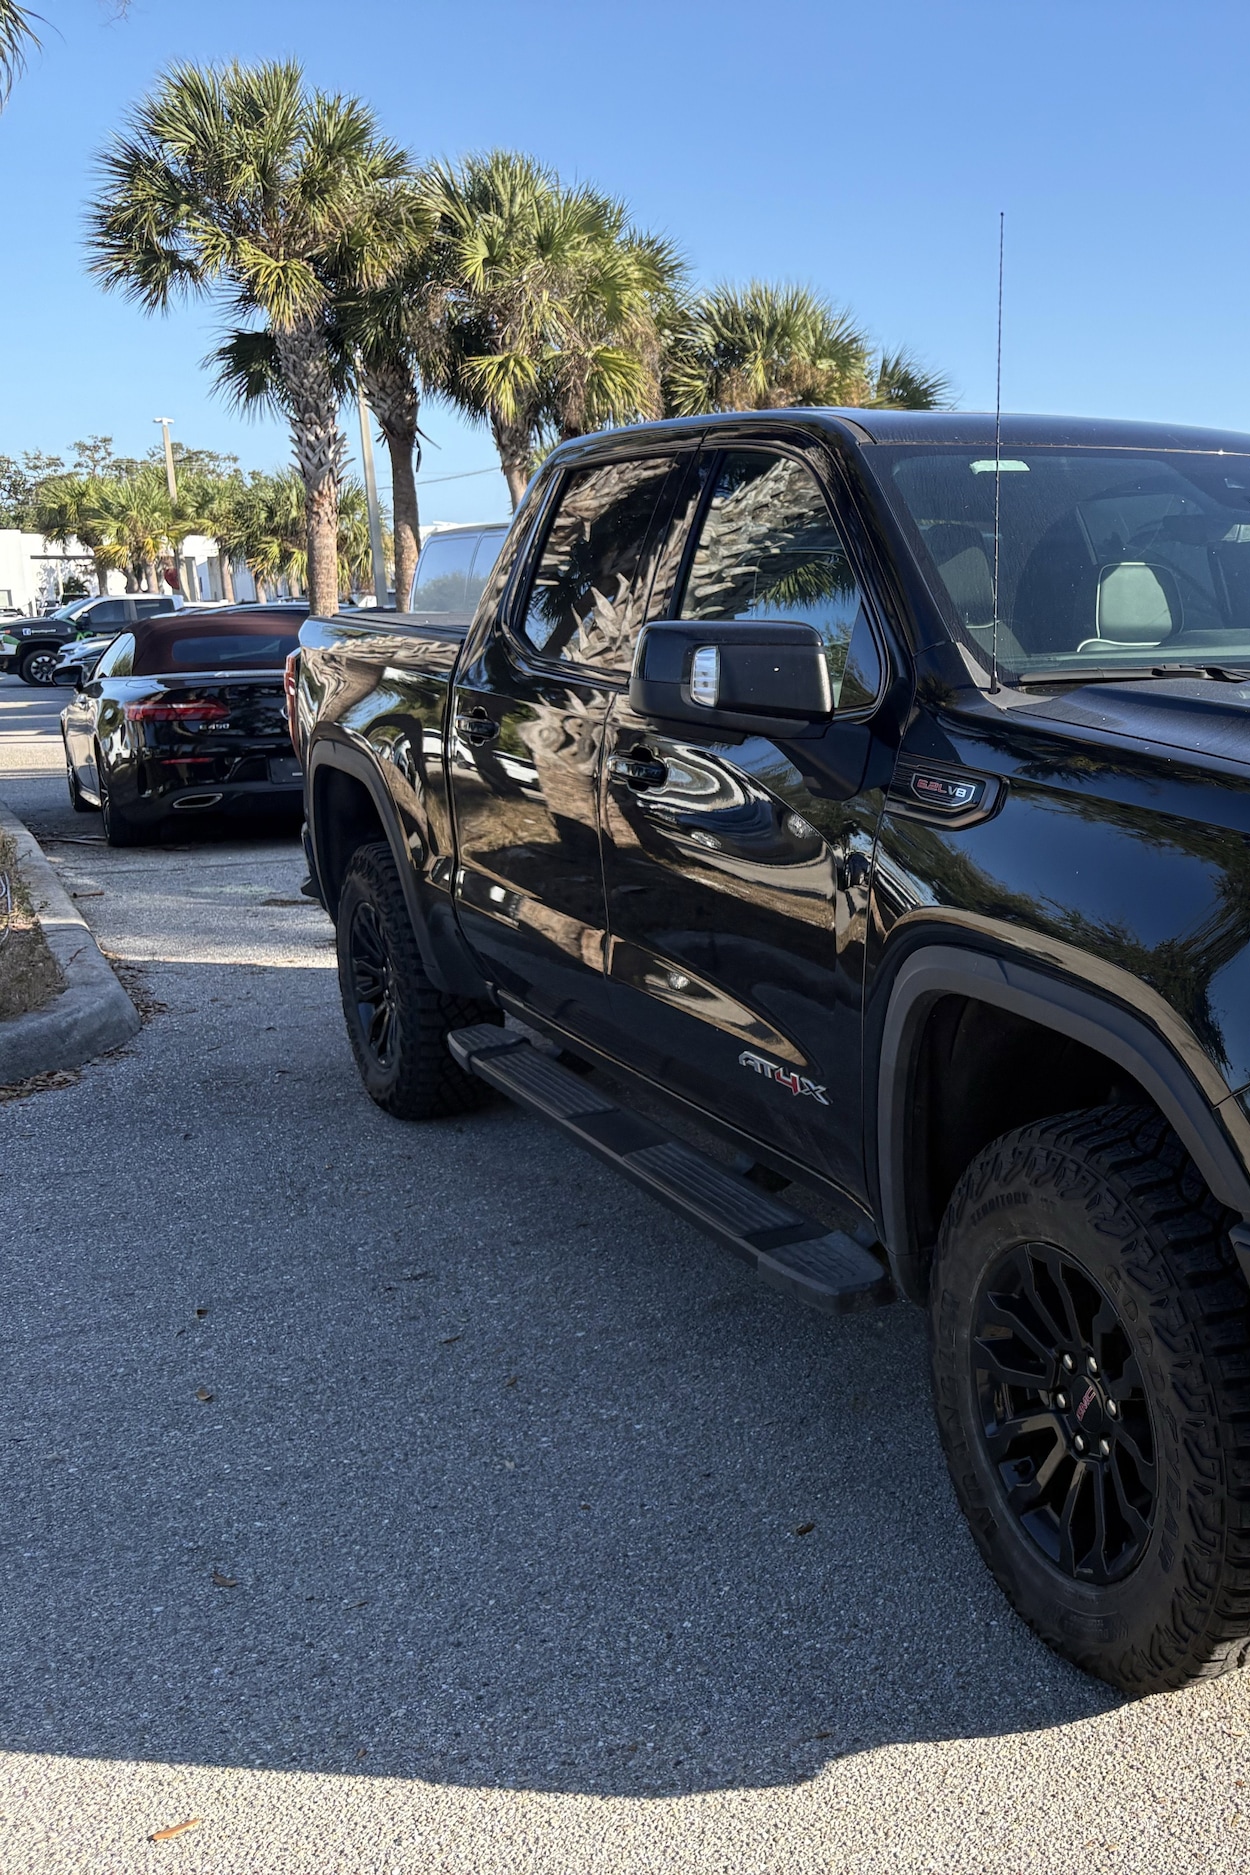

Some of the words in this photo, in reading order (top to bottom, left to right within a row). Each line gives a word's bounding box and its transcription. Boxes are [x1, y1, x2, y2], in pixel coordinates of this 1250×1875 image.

[947, 785, 967, 798] V8
[738, 1050, 831, 1106] AT4X
[969, 1190, 1030, 1228] TERRITORY
[1076, 1385, 1097, 1422] GMC
[1103, 1262, 1182, 1574] GOODYEAR
